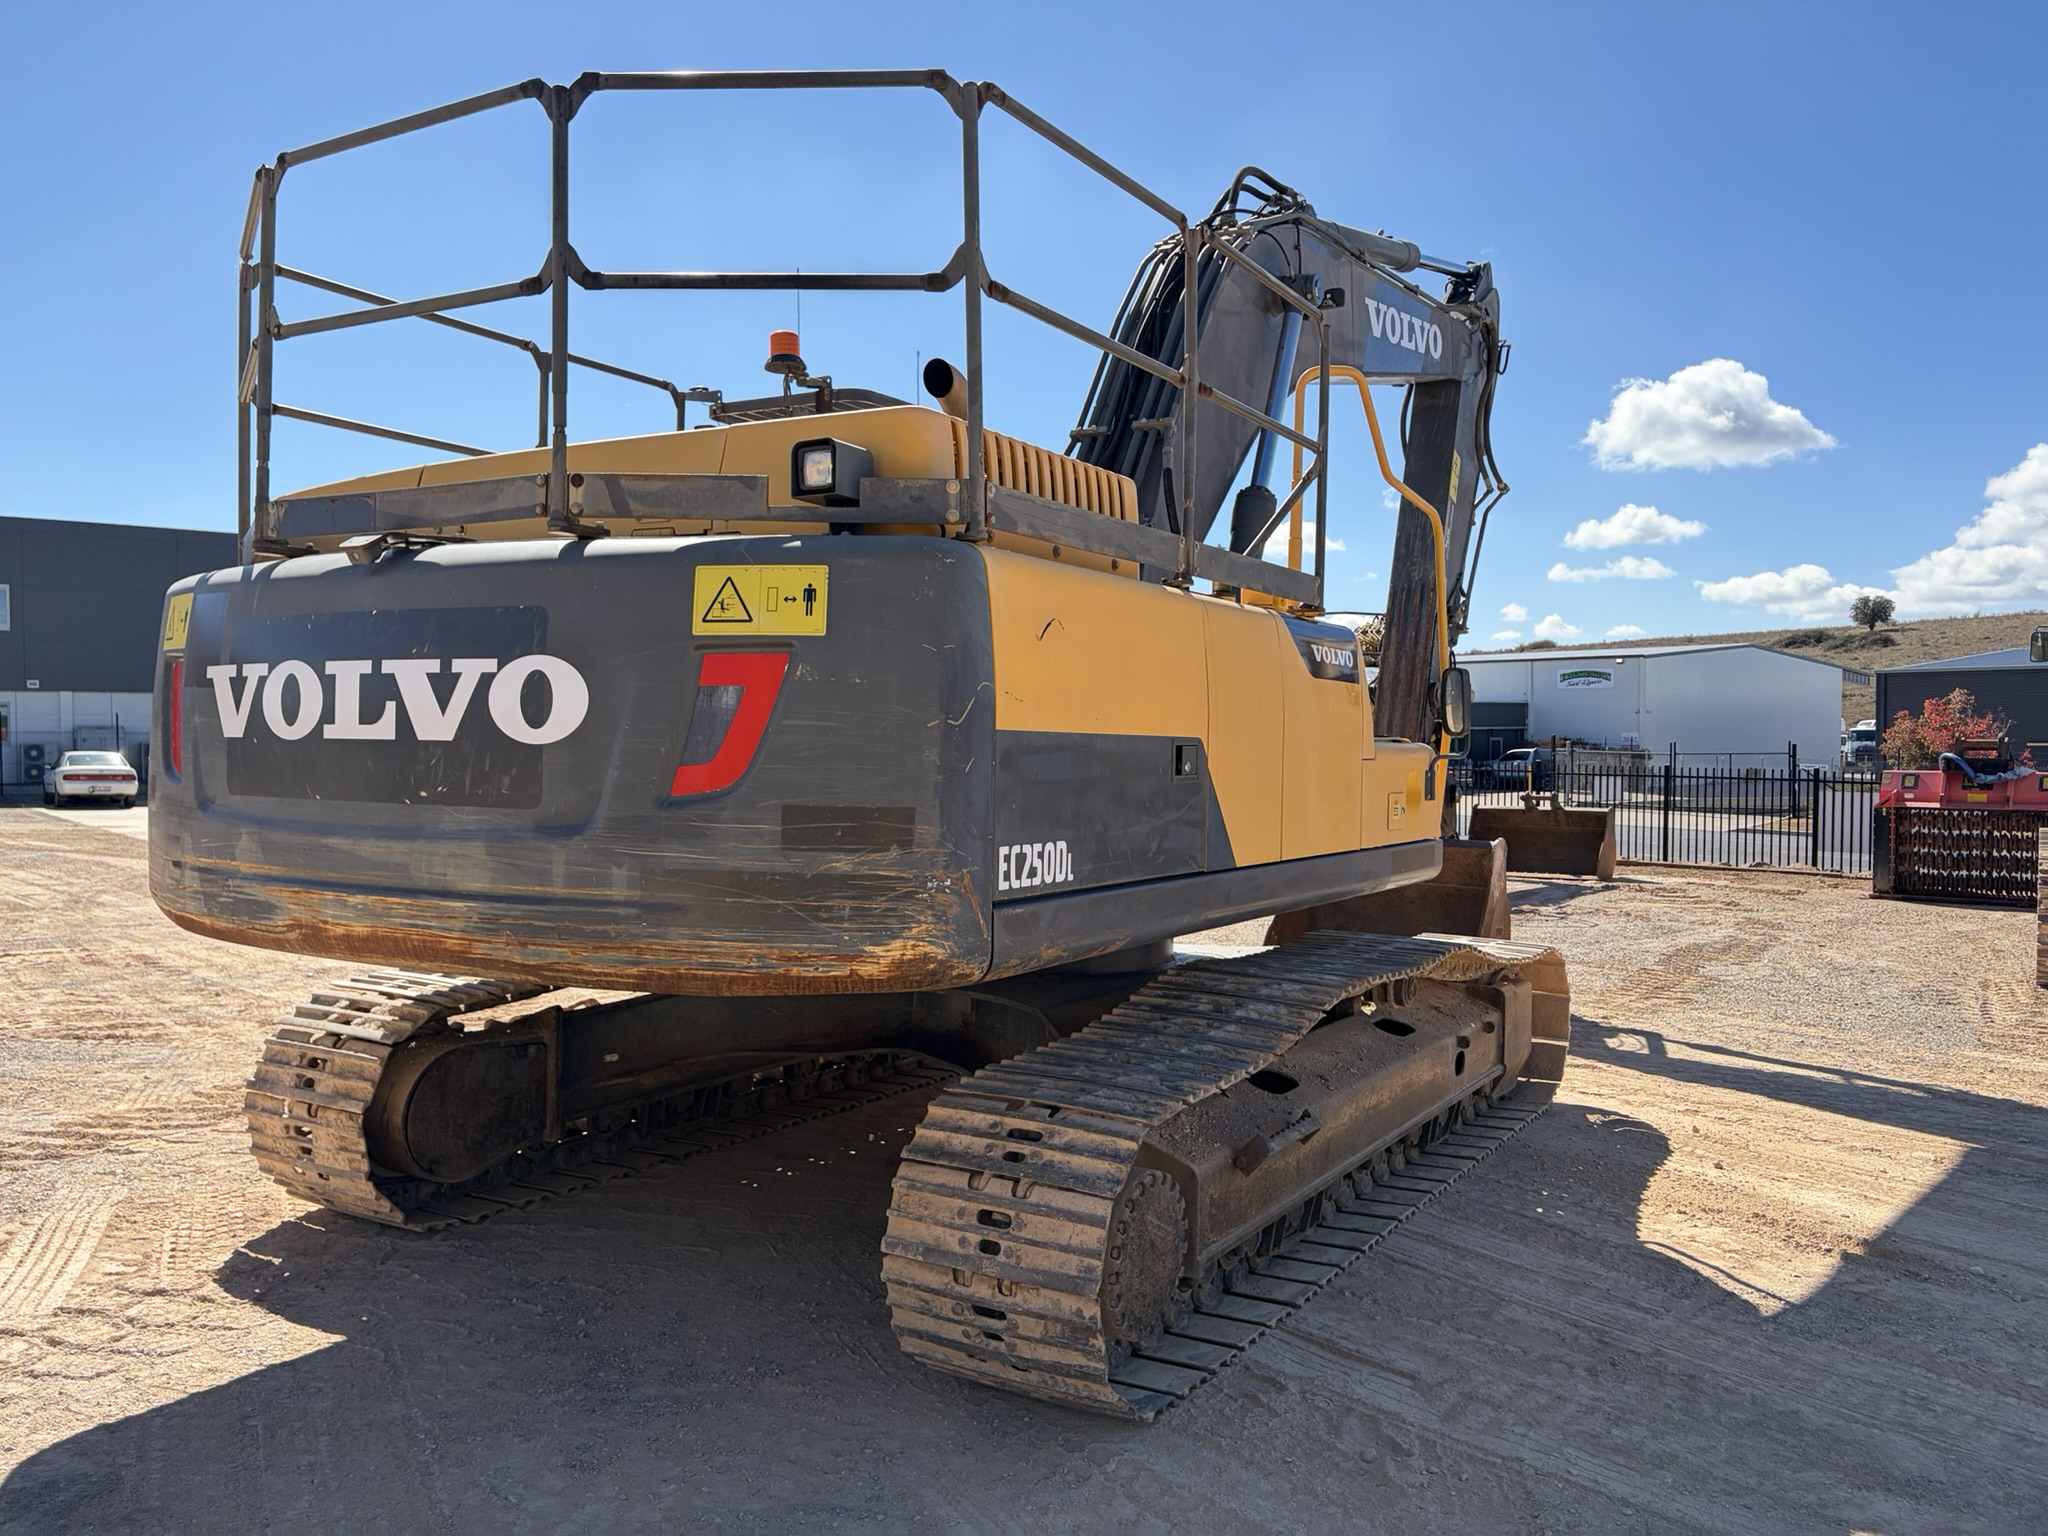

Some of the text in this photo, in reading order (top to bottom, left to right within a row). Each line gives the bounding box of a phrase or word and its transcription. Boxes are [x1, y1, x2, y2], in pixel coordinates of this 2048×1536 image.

[1365, 297, 1442, 359] VOLVO
[1311, 644, 1354, 668] VOLVO
[206, 654, 589, 745] VOLVO
[998, 840, 1074, 891] EC250DL
